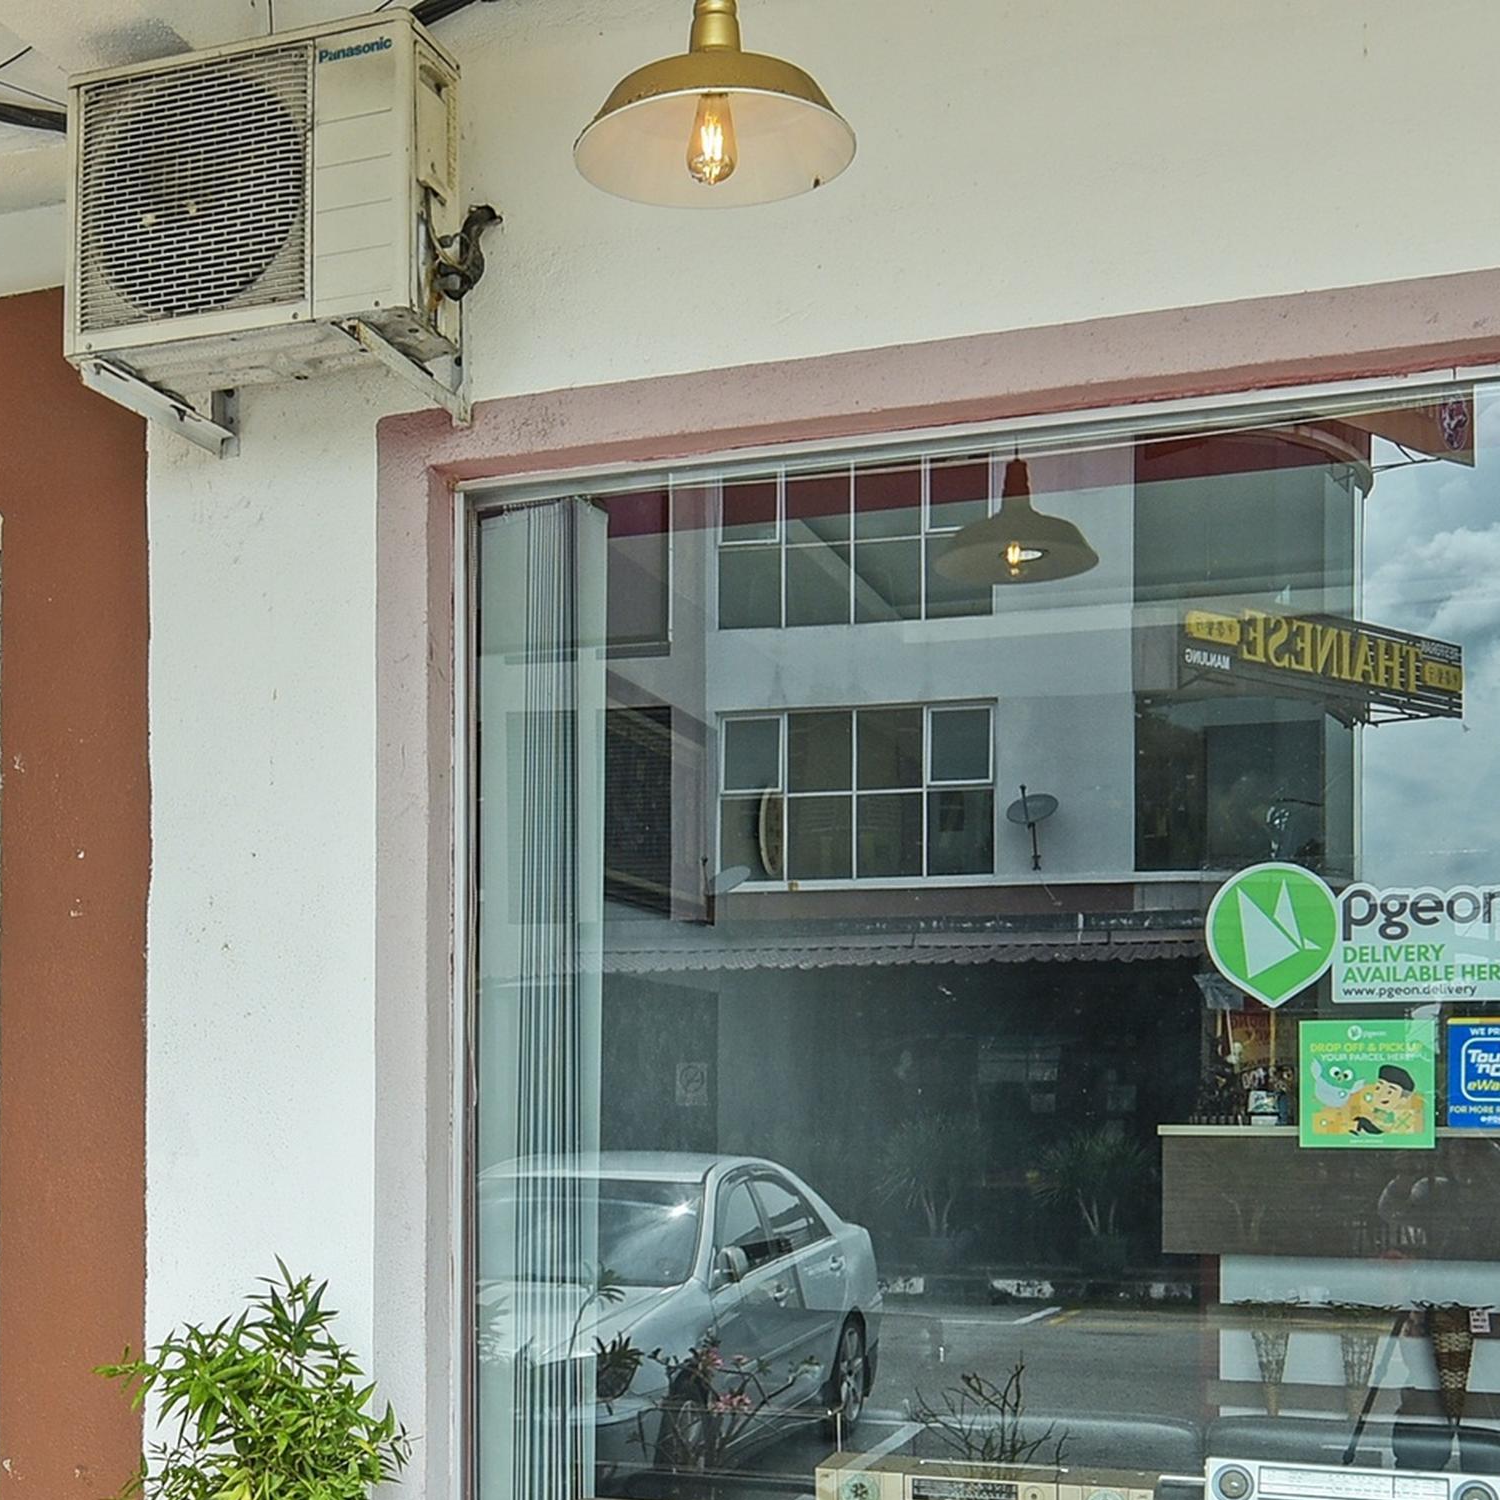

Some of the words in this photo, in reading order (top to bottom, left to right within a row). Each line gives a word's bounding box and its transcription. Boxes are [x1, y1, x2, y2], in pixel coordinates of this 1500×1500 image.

[319, 36, 393, 64] Panasonic
[1343, 943, 1445, 964] DELIVERY
[1343, 965, 1455, 984] AVAILABLE
[1342, 984, 1478, 999] www.pgeon.delivery
[1469, 1027, 1485, 1036] WE
[1449, 1105, 1467, 1114] FOR
[1468, 1105, 1494, 1114] MORE
